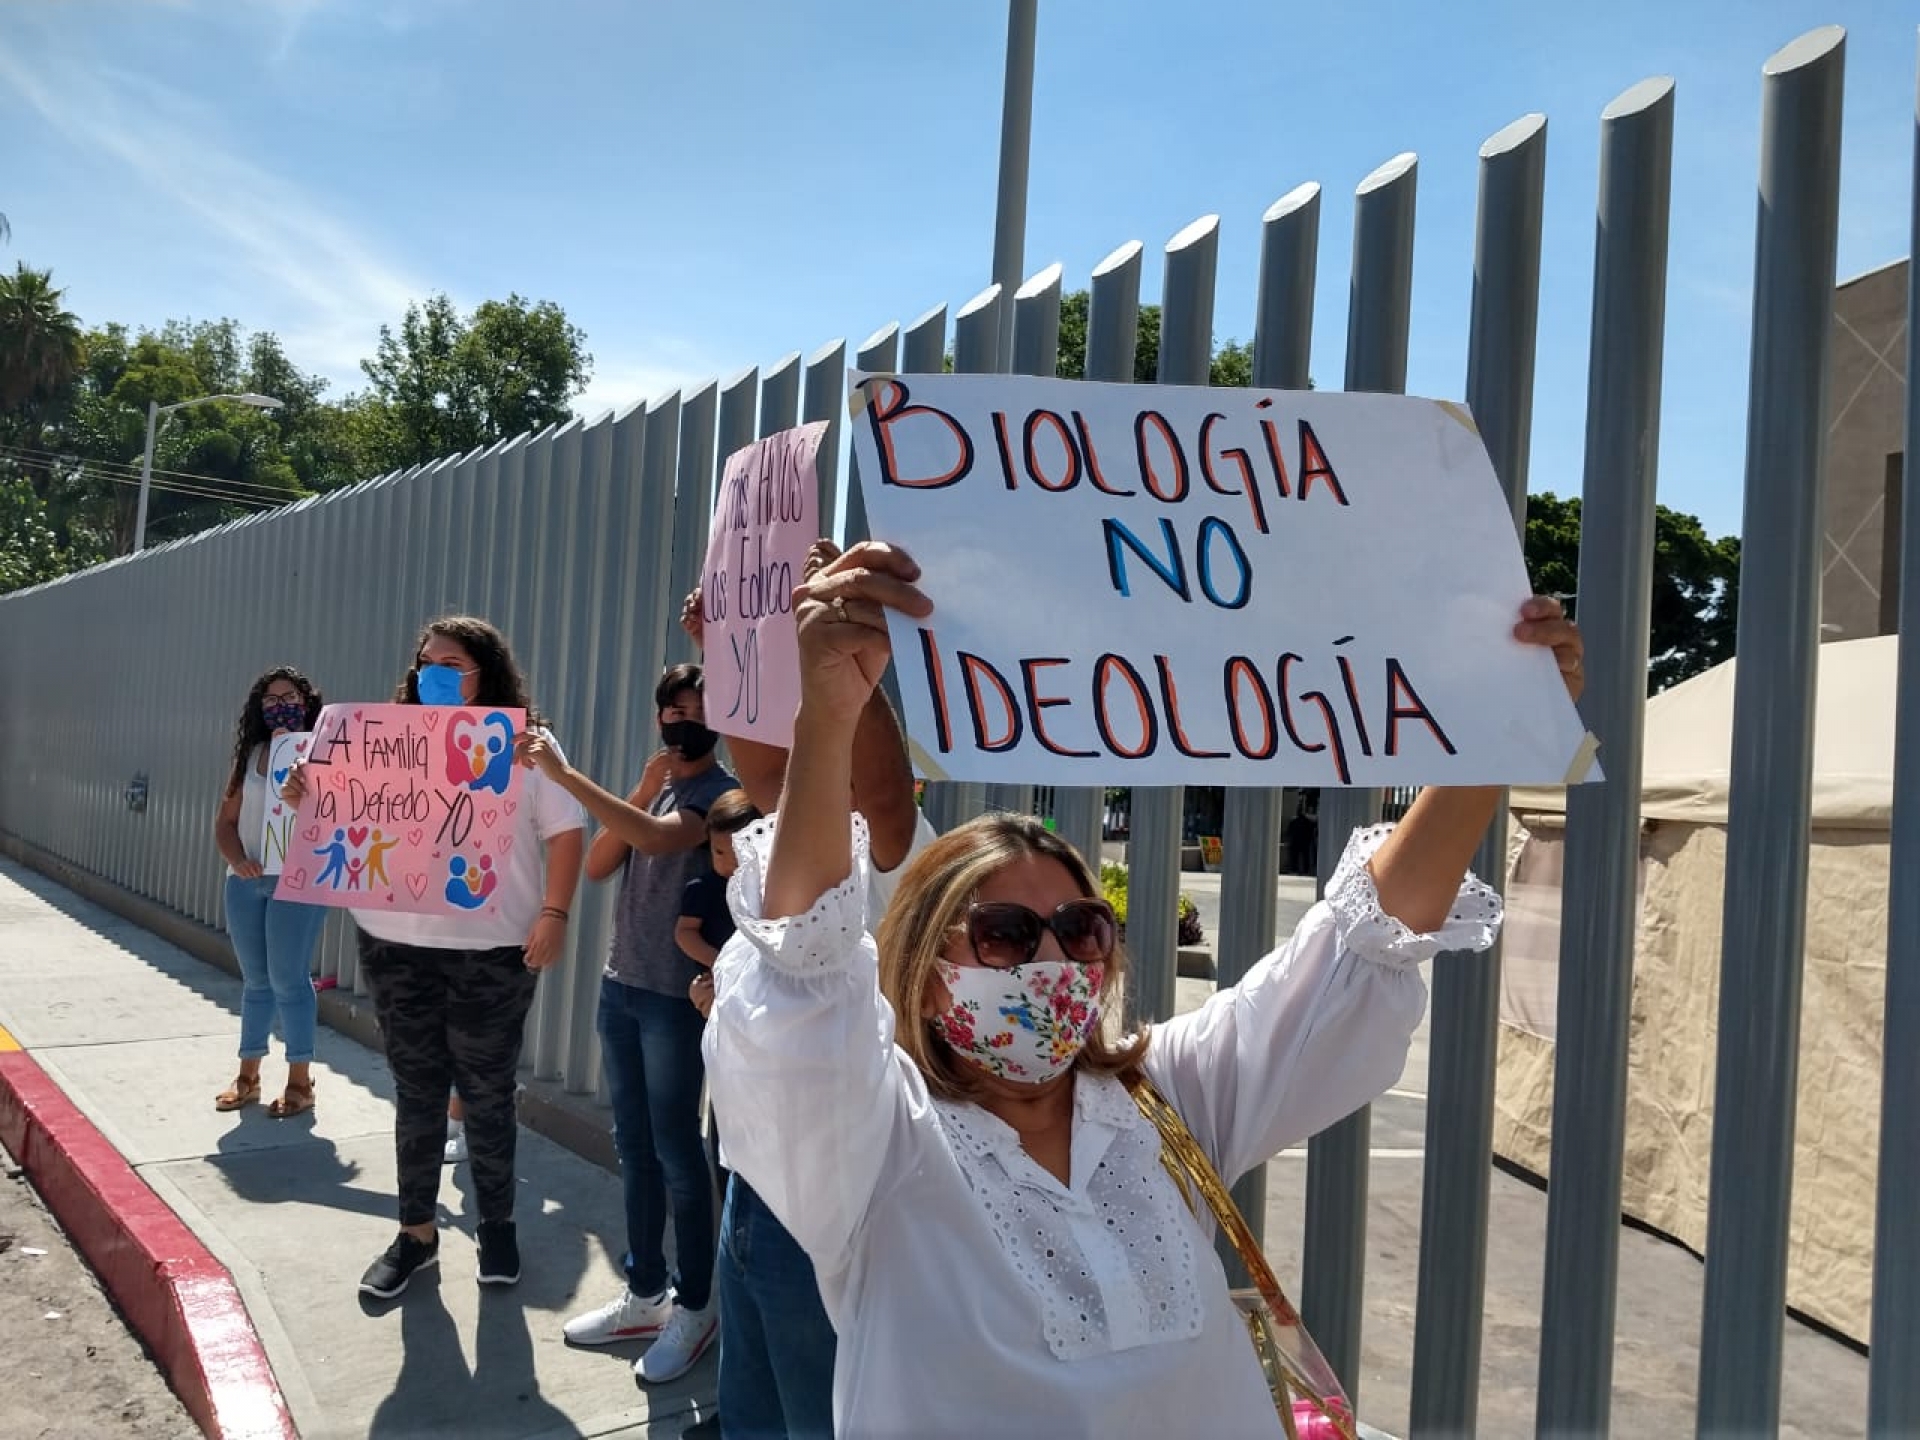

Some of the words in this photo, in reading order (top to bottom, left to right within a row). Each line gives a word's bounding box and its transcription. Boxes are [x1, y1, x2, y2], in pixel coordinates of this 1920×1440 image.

[855, 377, 1350, 534] BIOLOGÍA
[1101, 515, 1253, 609] NO
[727, 628, 759, 724] YO
[918, 627, 1458, 785] IDEOLOGÍA
[308, 711, 352, 766] LA
[434, 788, 474, 847] YO
